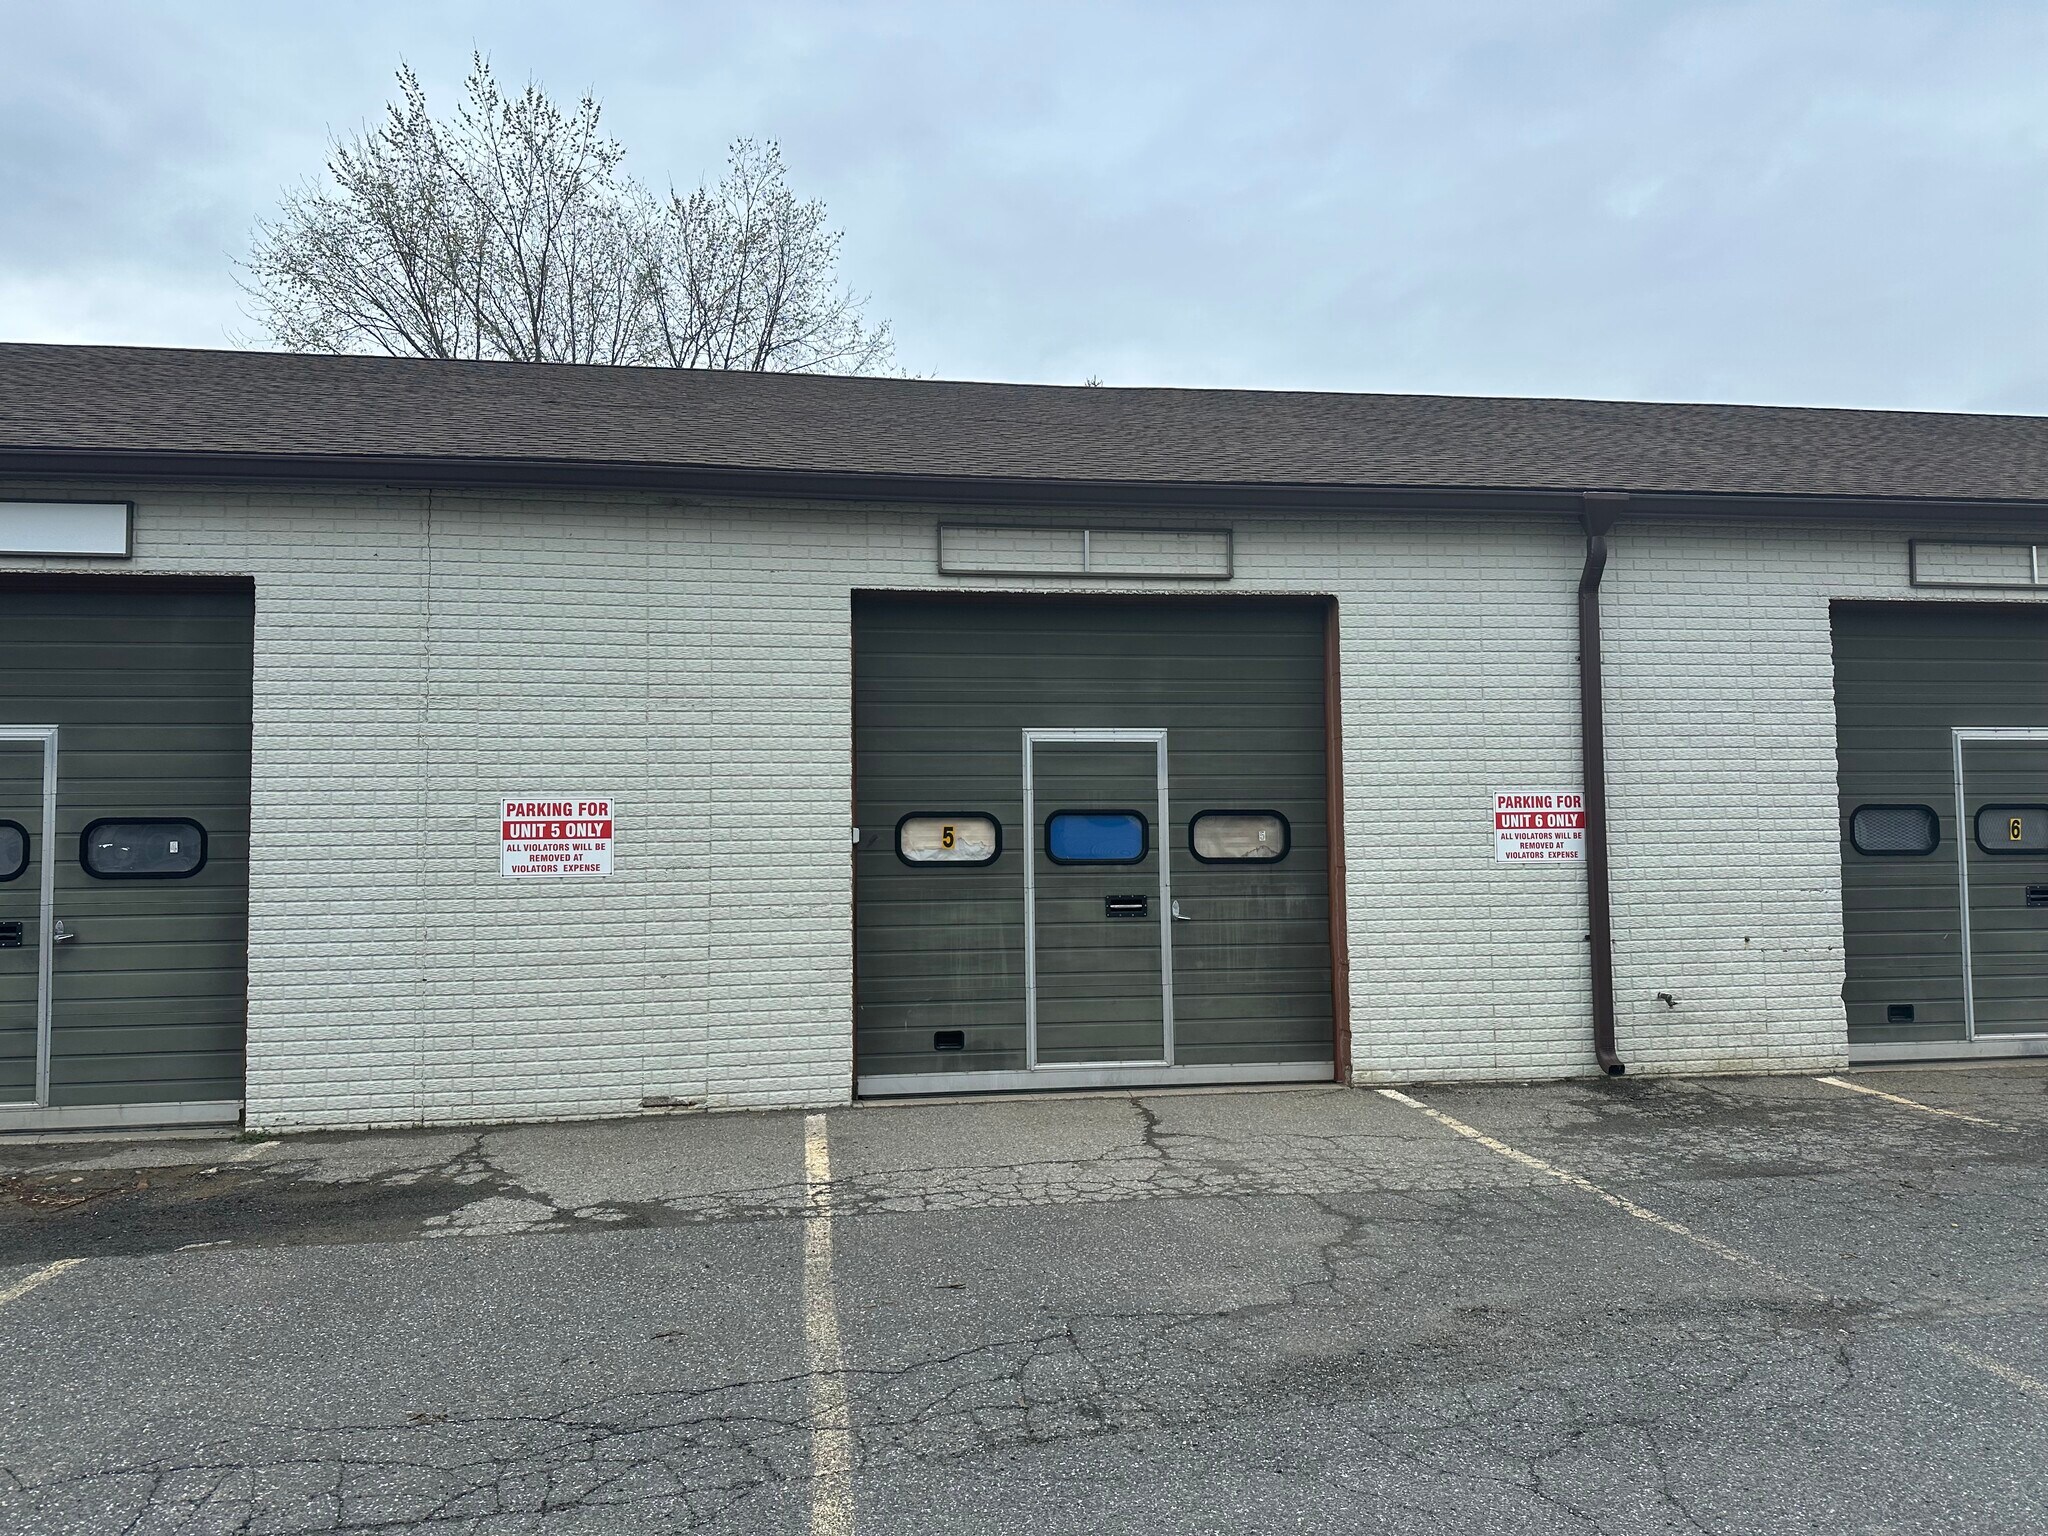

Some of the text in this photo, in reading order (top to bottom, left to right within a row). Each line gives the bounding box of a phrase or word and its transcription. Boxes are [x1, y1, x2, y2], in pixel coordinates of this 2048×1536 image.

[1497, 795, 1581, 809] PARKING FOR
[506, 802, 608, 817] PARKING FOR
[1501, 814, 1578, 828] UNIT 6 ONLY
[509, 822, 604, 838] UNIT 5 ONLY
[2012, 819, 2020, 838] 6
[942, 826, 954, 848] 5
[1500, 832, 1513, 840] ALL
[1514, 832, 1552, 840] VIOLATORS
[506, 844, 521, 852] ALL
[523, 843, 570, 852] VIOLATORS
[572, 843, 592, 851] WILL
[1555, 841, 1564, 849] AT
[529, 853, 583, 862] REMOVED AT
[1505, 851, 1544, 859] VIOLATORS
[511, 864, 600, 873] VIOLATORS EXPENSE
